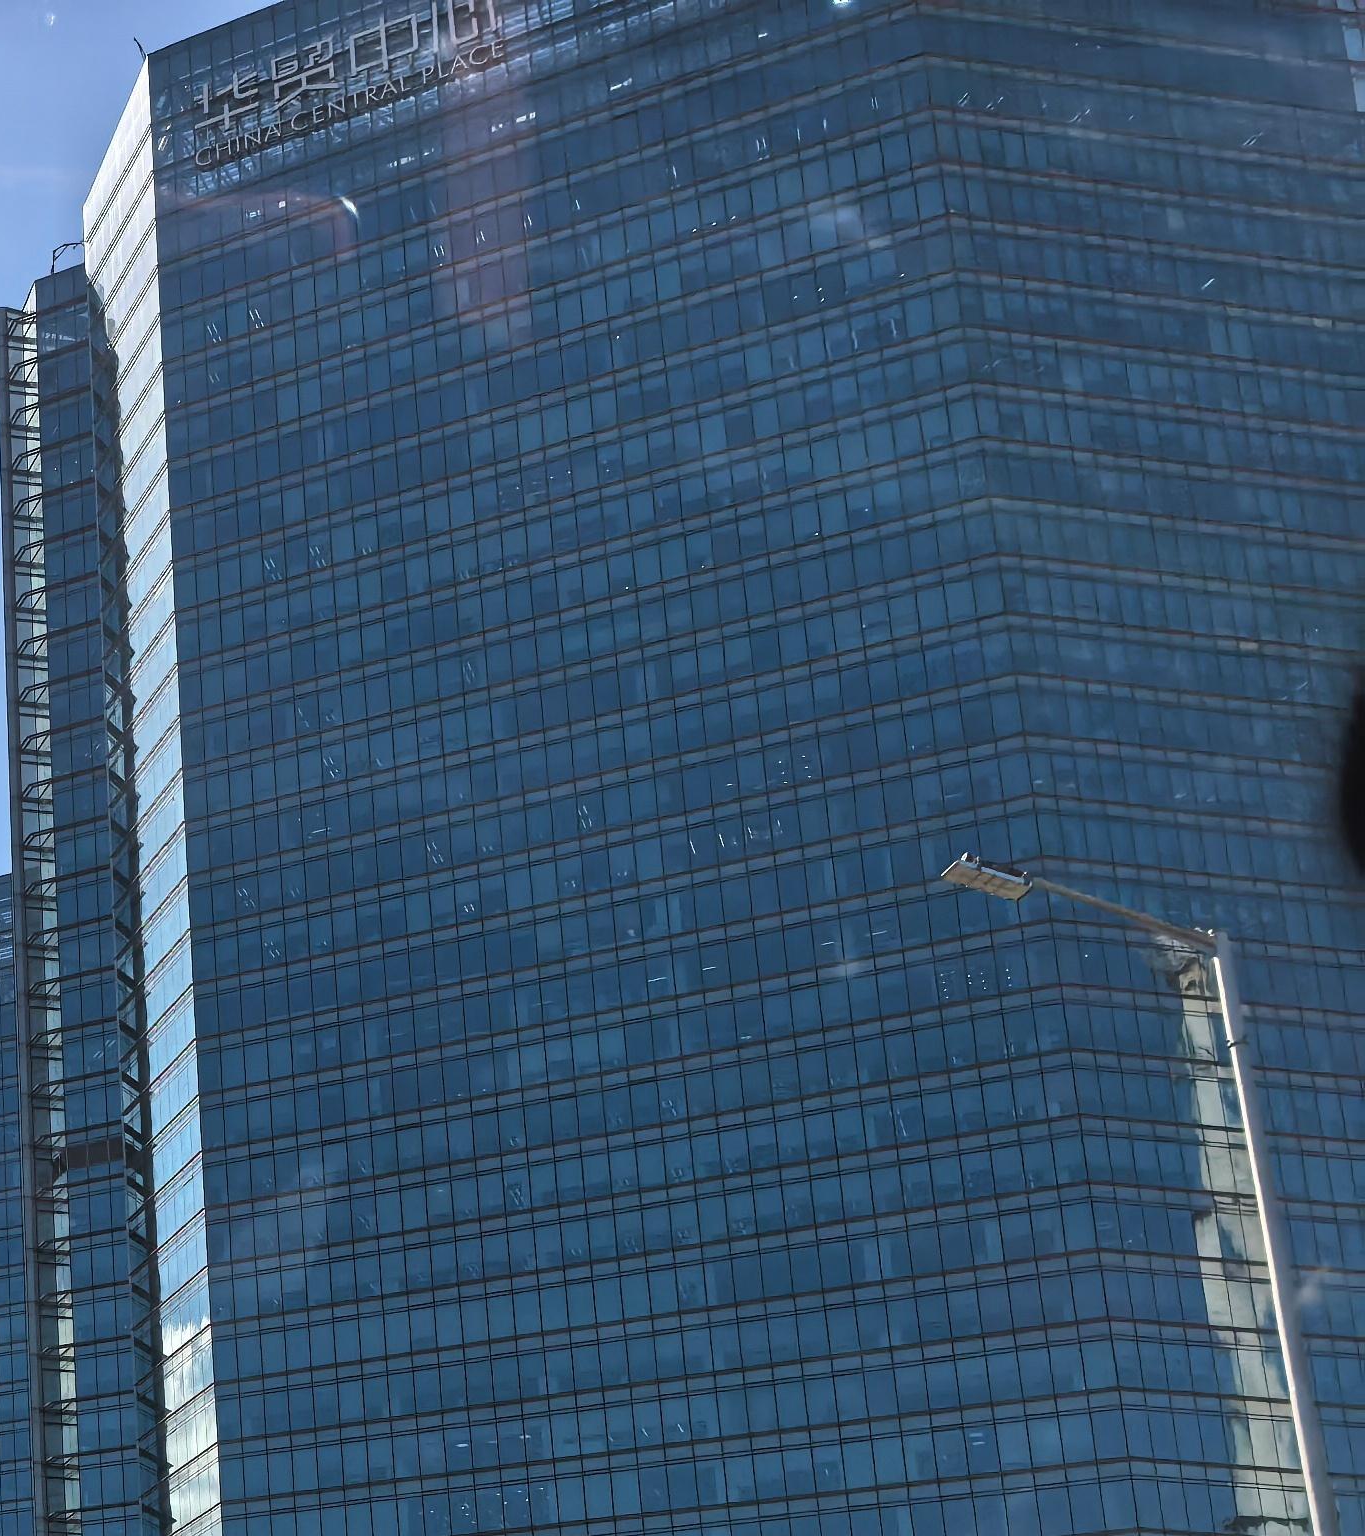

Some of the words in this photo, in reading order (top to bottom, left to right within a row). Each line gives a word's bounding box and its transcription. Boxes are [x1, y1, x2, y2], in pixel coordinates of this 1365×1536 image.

[195, 123, 282, 167] CHINA
[290, 74, 412, 131] CENTRAL
[422, 38, 506, 85] PLACE
